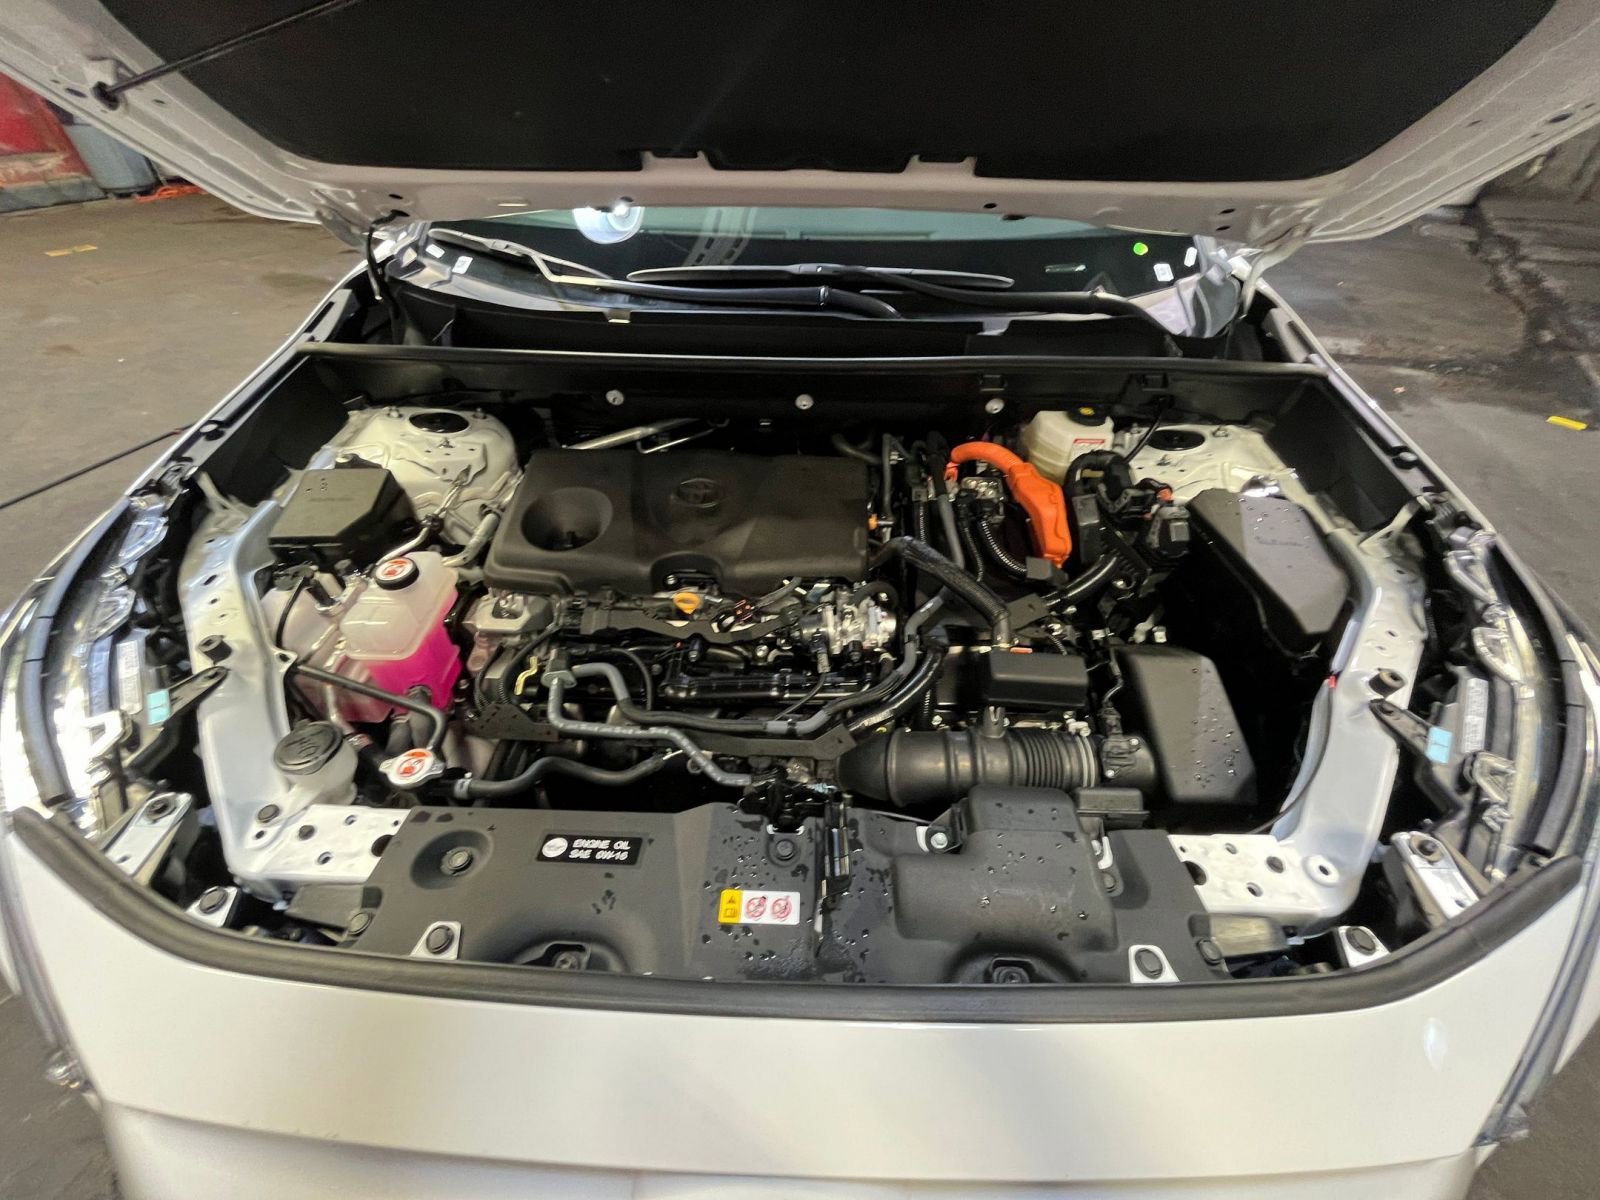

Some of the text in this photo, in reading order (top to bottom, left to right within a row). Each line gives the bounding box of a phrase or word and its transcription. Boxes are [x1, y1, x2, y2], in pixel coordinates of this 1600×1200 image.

[572, 838, 631, 850] ENGINE OIL
[568, 849, 592, 859] SAE
